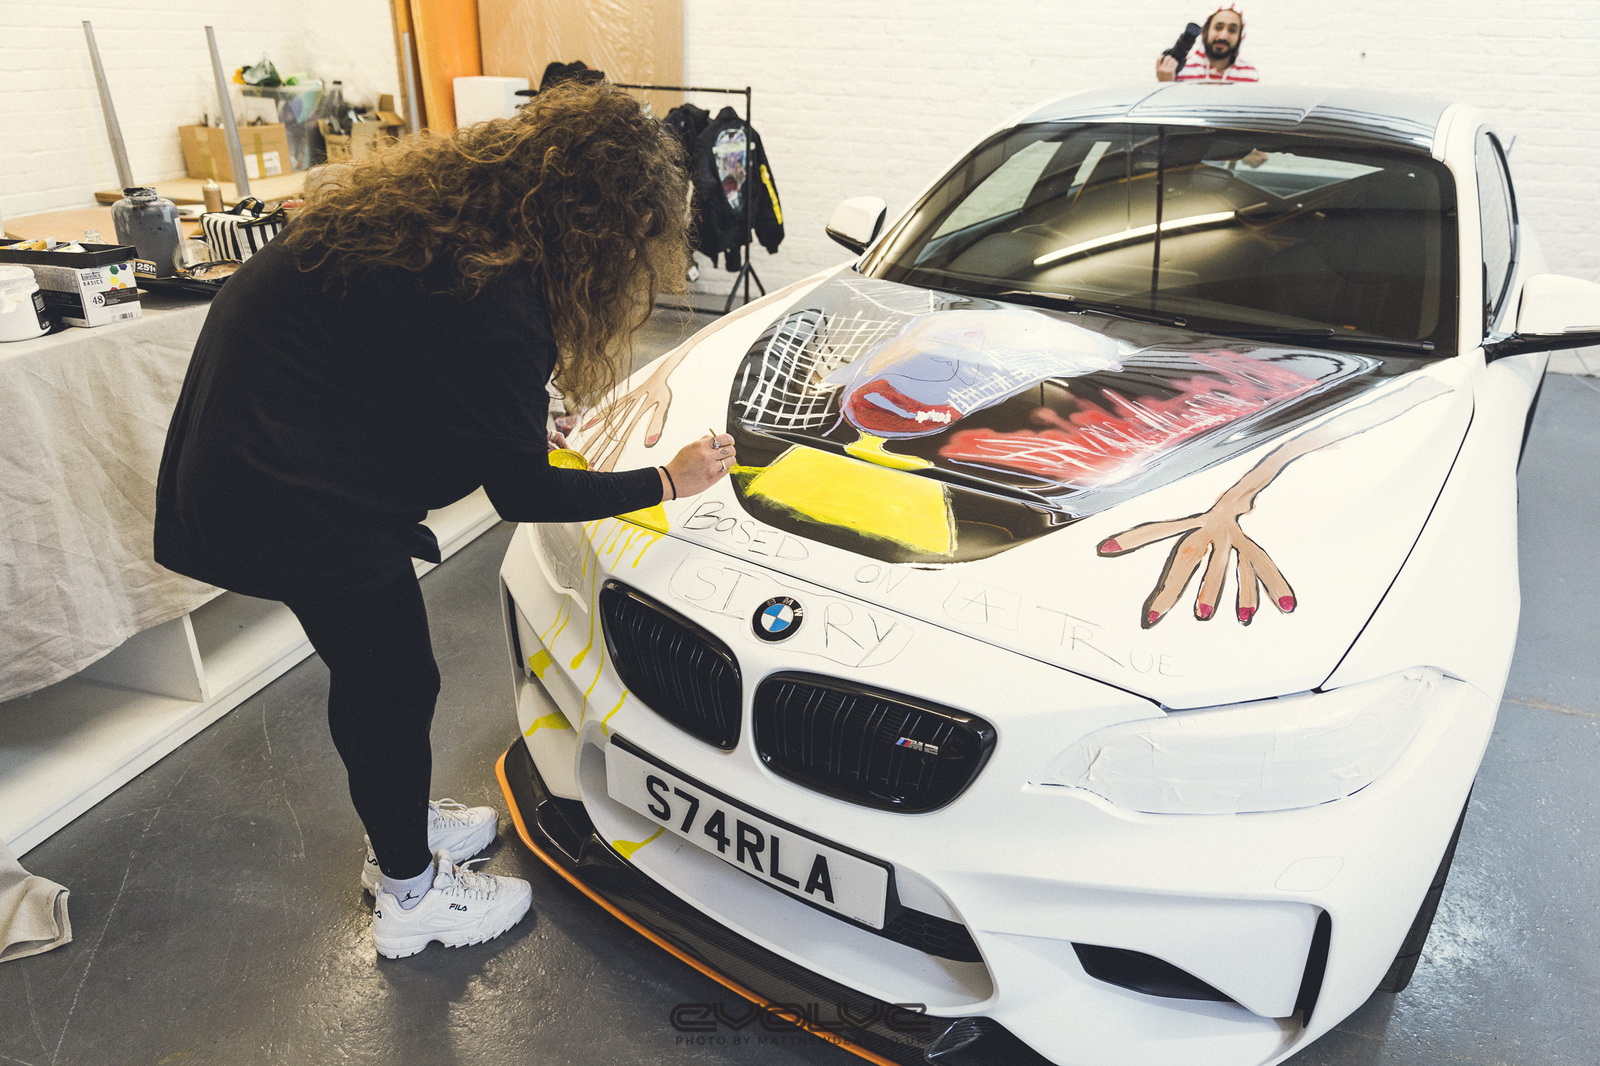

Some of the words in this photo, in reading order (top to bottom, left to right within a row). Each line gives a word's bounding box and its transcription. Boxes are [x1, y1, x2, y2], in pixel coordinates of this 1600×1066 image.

[83, 278, 104, 287] BASICS
[92, 295, 104, 305] 48
[854, 564, 913, 594] ON
[961, 590, 1005, 622] A
[1036, 605, 1185, 677] TRUE
[904, 739, 939, 756] M2
[646, 774, 835, 904] S74RLA
[449, 903, 468, 912] FILA
